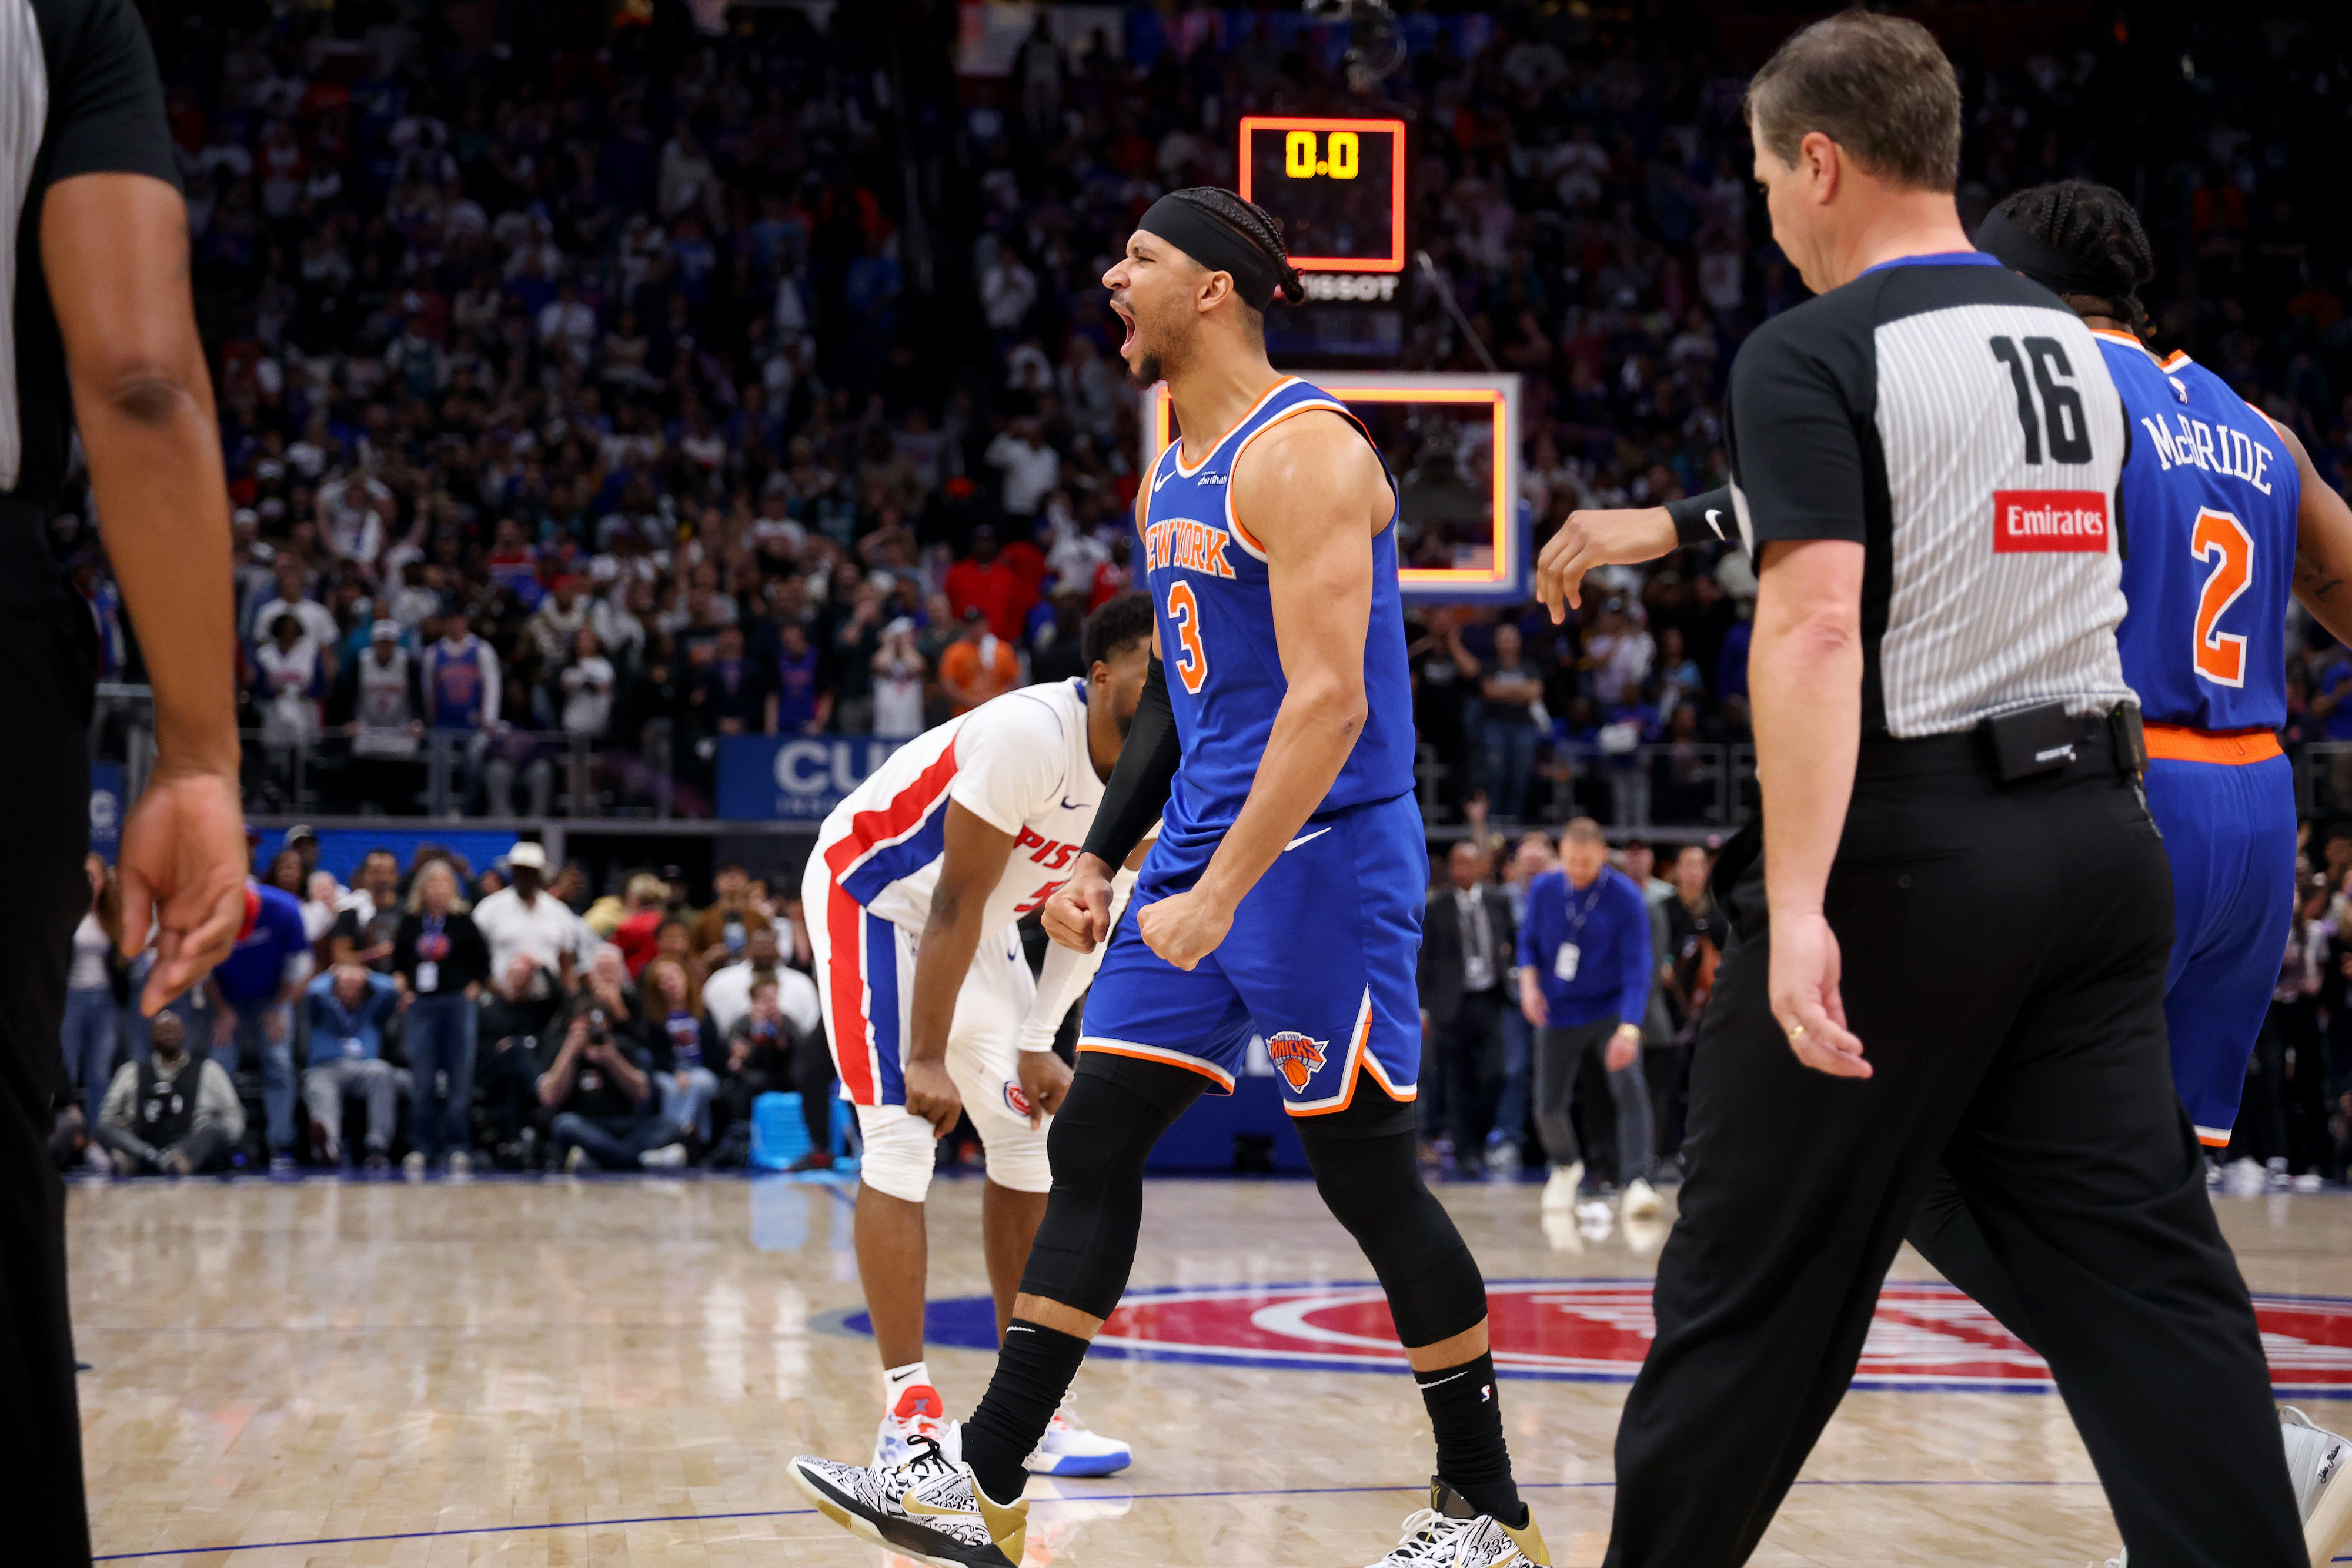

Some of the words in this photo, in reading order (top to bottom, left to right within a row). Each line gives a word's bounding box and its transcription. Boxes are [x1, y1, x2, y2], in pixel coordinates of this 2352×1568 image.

[1285, 130, 1359, 179] 0.0
[1989, 335, 2093, 465] 16
[2141, 413, 2273, 496] McBRIDE
[1145, 520, 1175, 576] EW
[1173, 517, 1237, 580] YORK
[2007, 504, 2104, 537] Emirates
[2191, 505, 2254, 688] 2
[1167, 579, 1208, 695] 3
[773, 739, 891, 795] CU
[1013, 824, 1081, 871] PIS
[1271, 1038, 1324, 1063] KNICKS
